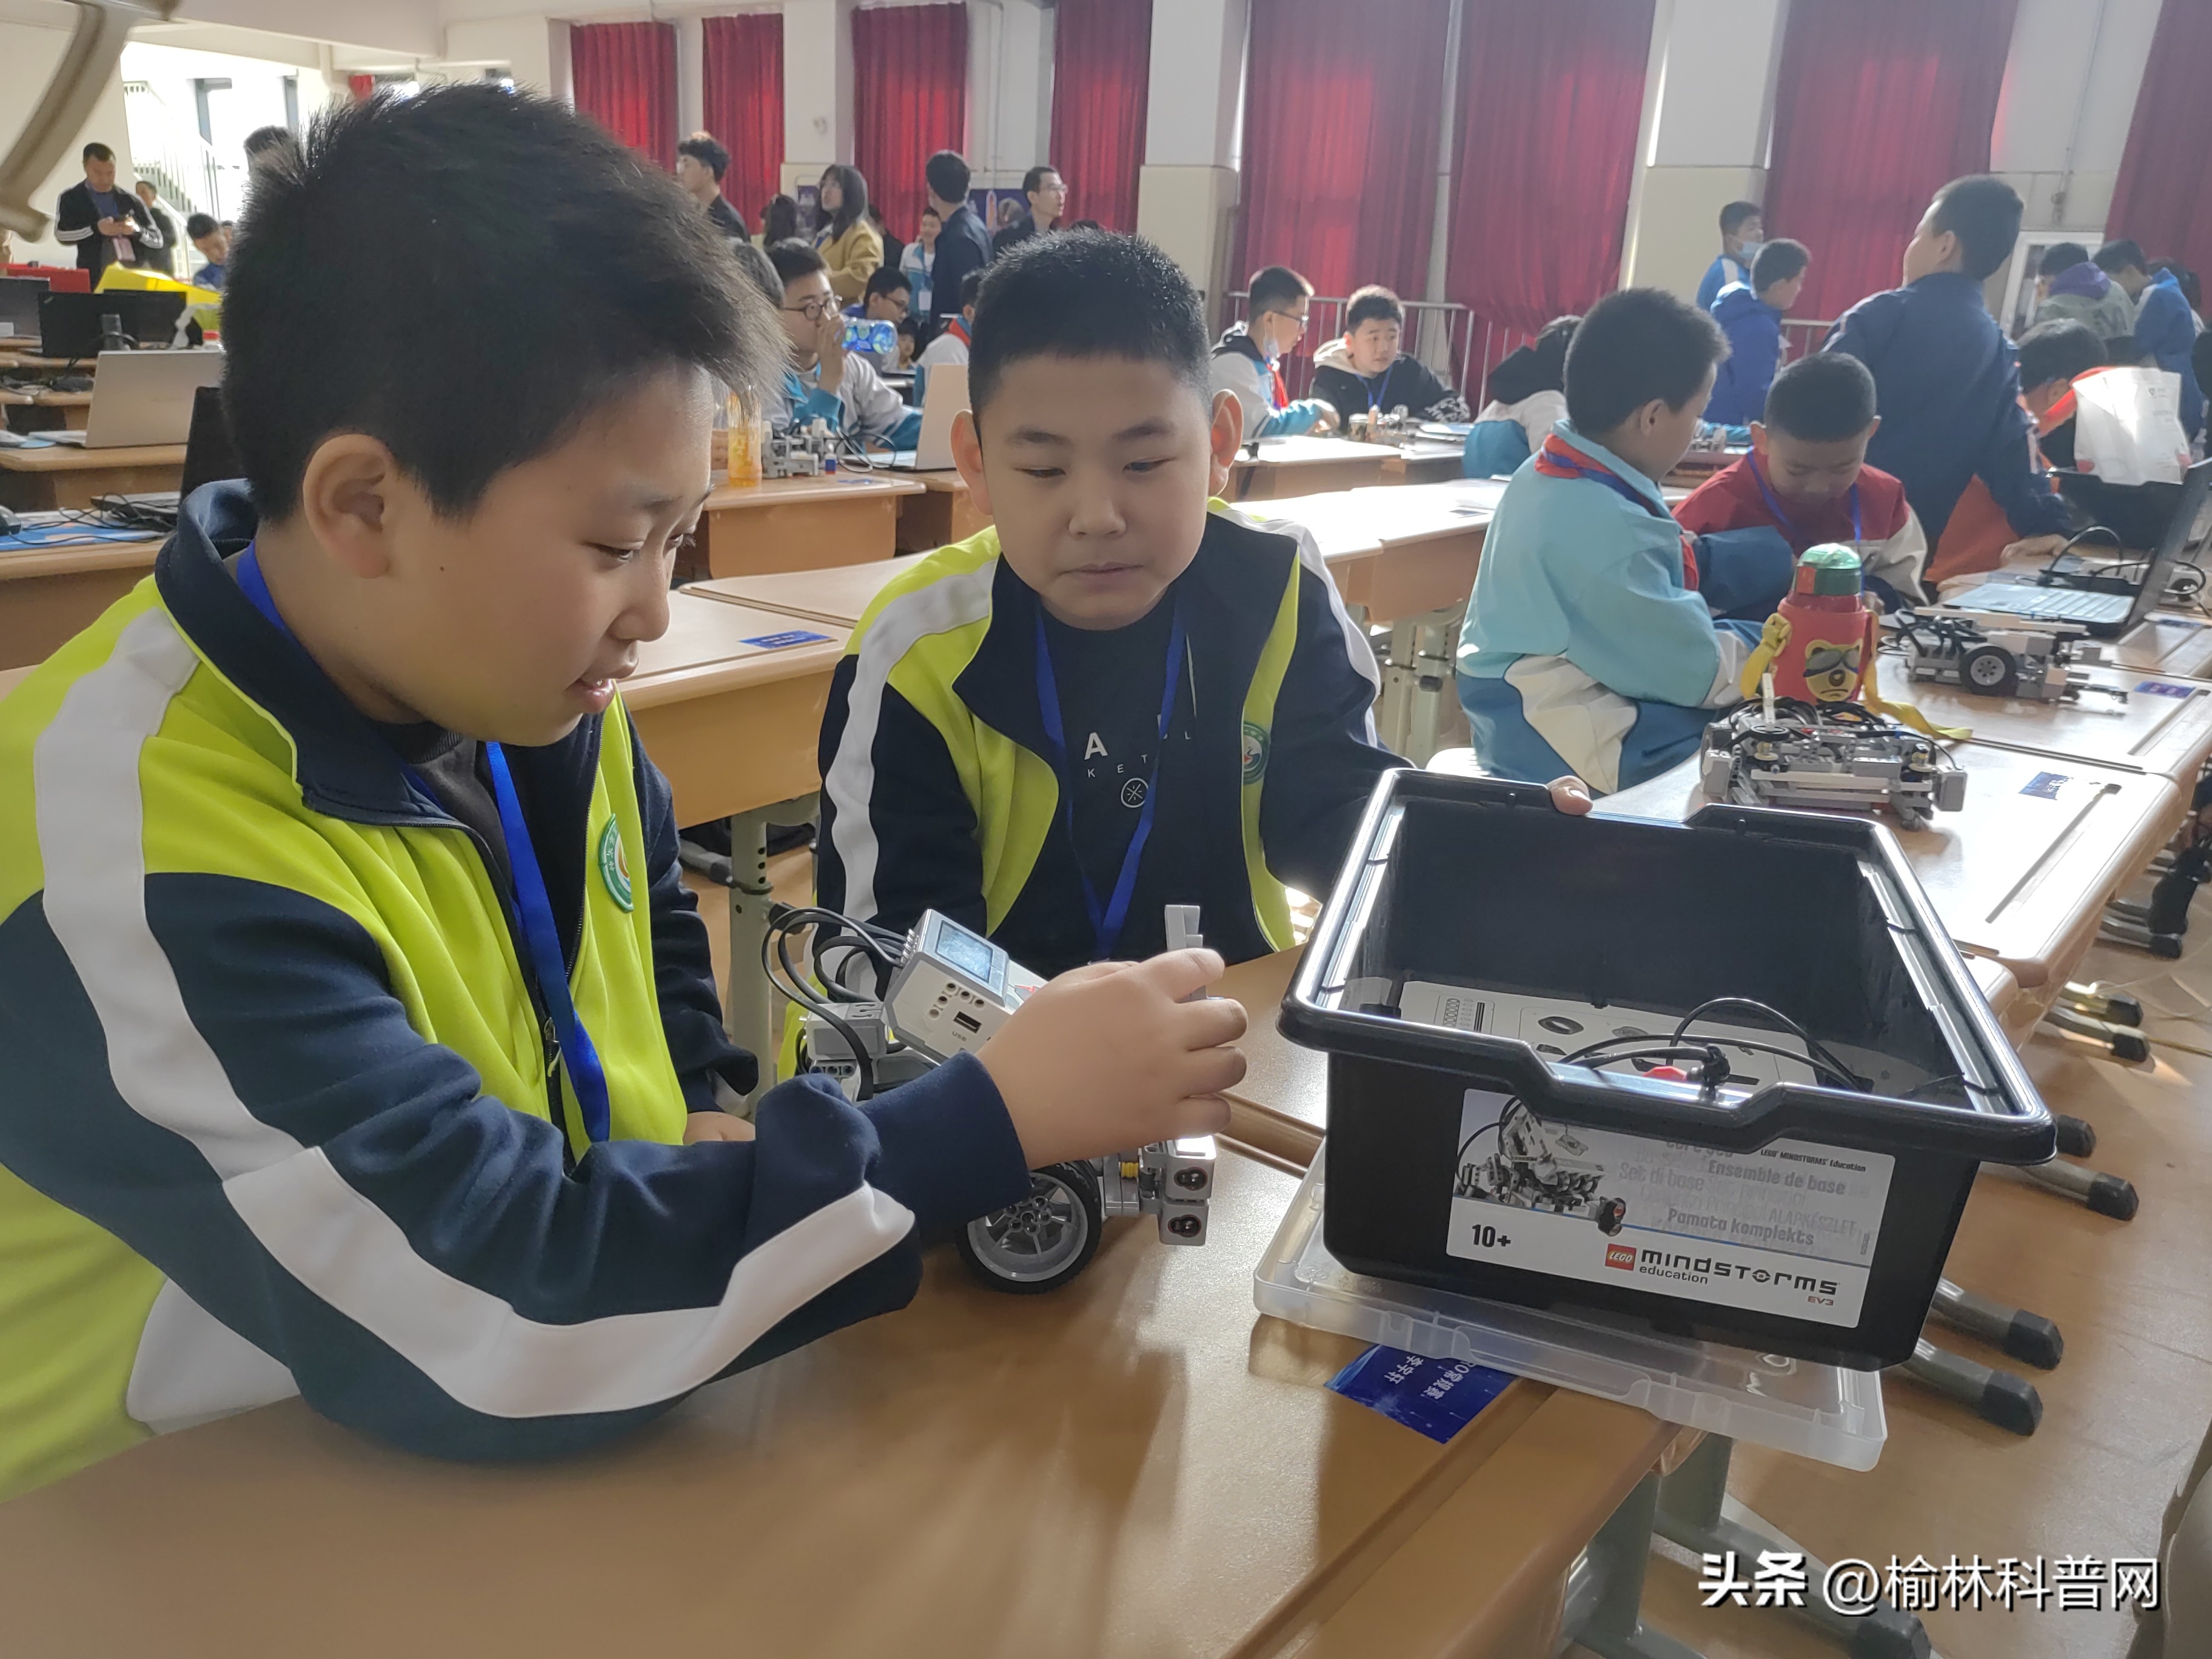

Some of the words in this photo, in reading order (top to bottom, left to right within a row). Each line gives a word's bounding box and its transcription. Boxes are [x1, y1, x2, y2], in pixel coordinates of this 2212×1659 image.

[951, 1030, 967, 1042] USB
[1829, 1159, 1867, 1173] Education
[1618, 1161, 1647, 1182] Set
[1649, 1167, 1664, 1184] di
[1667, 1168, 1705, 1192] base
[1707, 1159, 1781, 1184] Ensemble
[1783, 1171, 1804, 1188] de
[1807, 1174, 1846, 1196] base
[1472, 1224, 1511, 1248] 10+
[1667, 1207, 1728, 1232] Pamata
[1731, 1217, 1815, 1245] komplekts
[1608, 1250, 1634, 1264] LEGO
[1639, 1265, 1709, 1285] education
[1806, 1295, 1834, 1307] EV3
